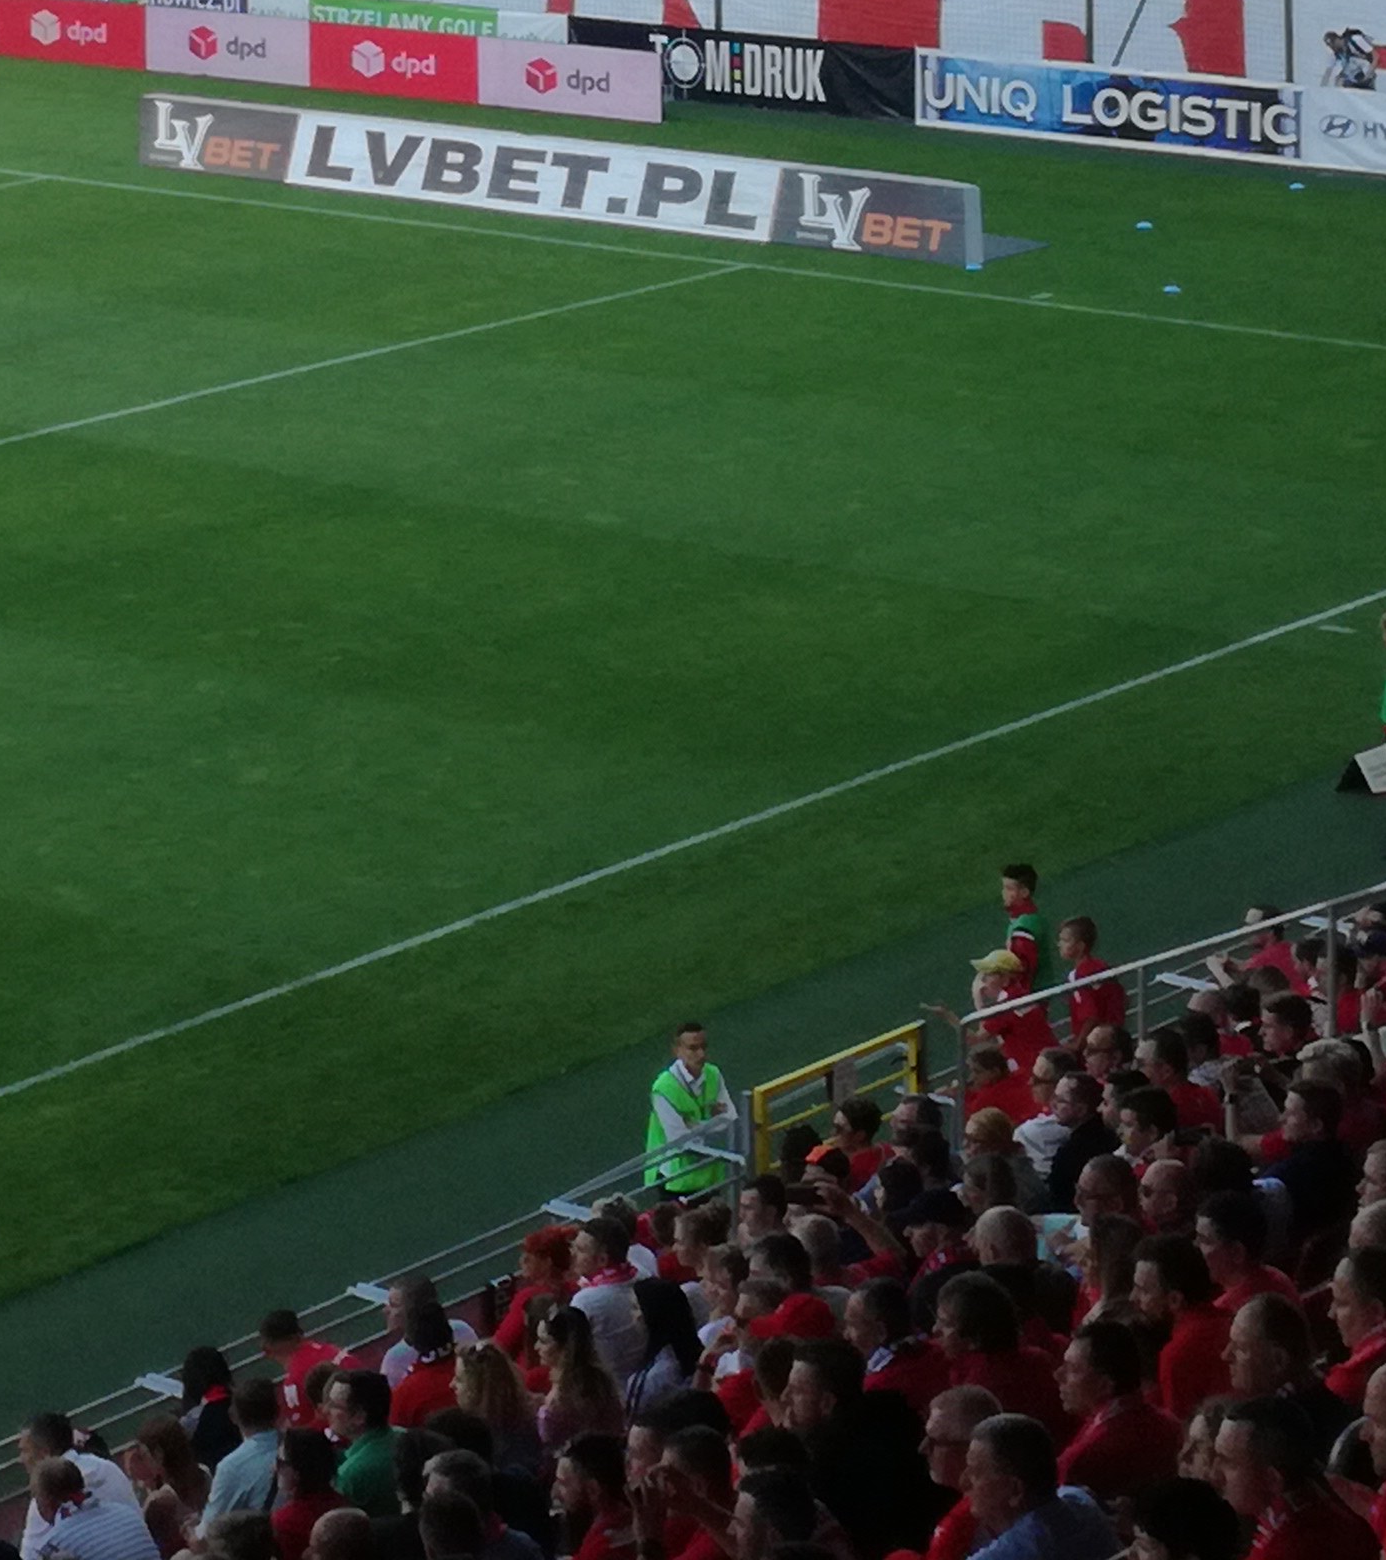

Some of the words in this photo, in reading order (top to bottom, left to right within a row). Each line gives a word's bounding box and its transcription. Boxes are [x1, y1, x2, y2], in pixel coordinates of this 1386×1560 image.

[67, 20, 108, 46] dpd
[225, 35, 267, 61] dpd
[391, 50, 437, 80] dpd
[565, 68, 611, 96] dpd
[924, 68, 1038, 123] UNIQ
[1061, 82, 1298, 146] LOGISTIC
[304, 124, 757, 234] LVBET.PL
